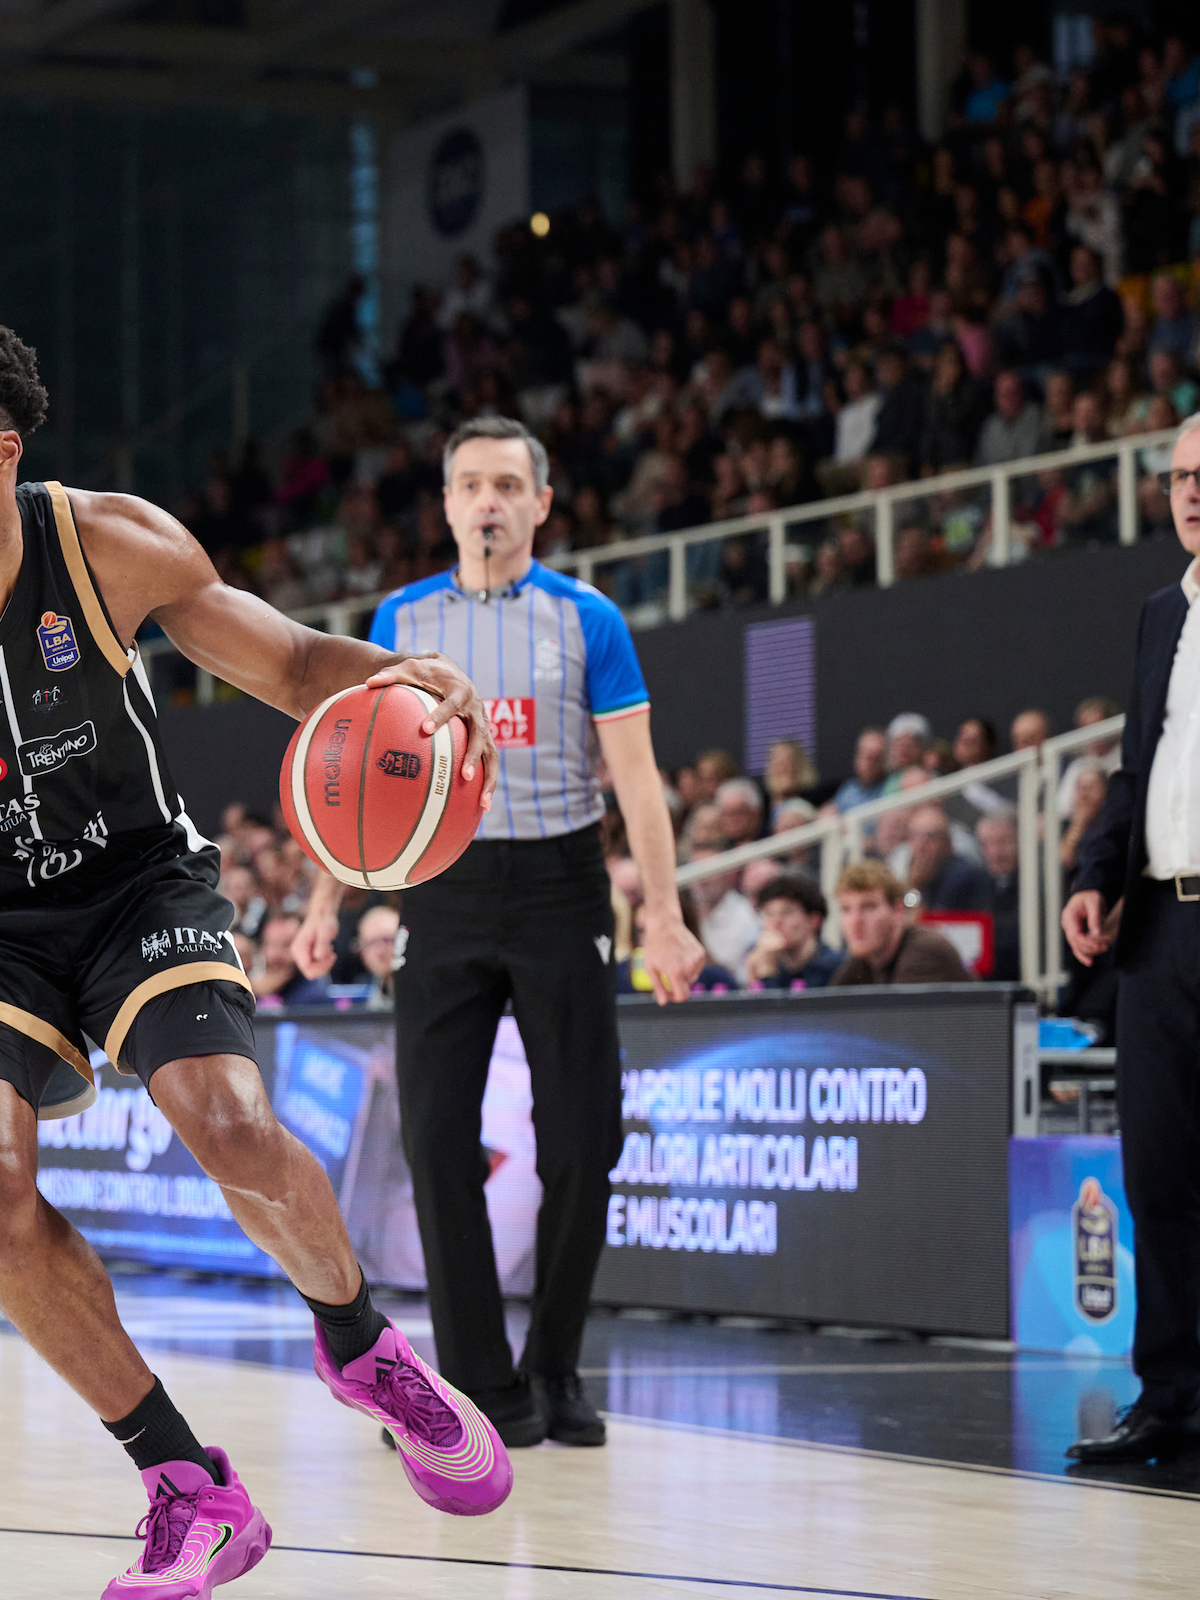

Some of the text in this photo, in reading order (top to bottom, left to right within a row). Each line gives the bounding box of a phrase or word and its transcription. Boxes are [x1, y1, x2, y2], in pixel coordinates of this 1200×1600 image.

[45, 633, 71, 649] LBA
[52, 651, 75, 664] Unipol
[26, 735, 88, 768] TRENTINO
[323, 718, 353, 807] molten
[434, 755, 448, 796] BG4500
[621, 1068, 928, 1125] APSULE MOLLI CONTRO
[700, 1134, 860, 1192] ARTICOLARI
[606, 1194, 778, 1256] E MUSCOLARI
